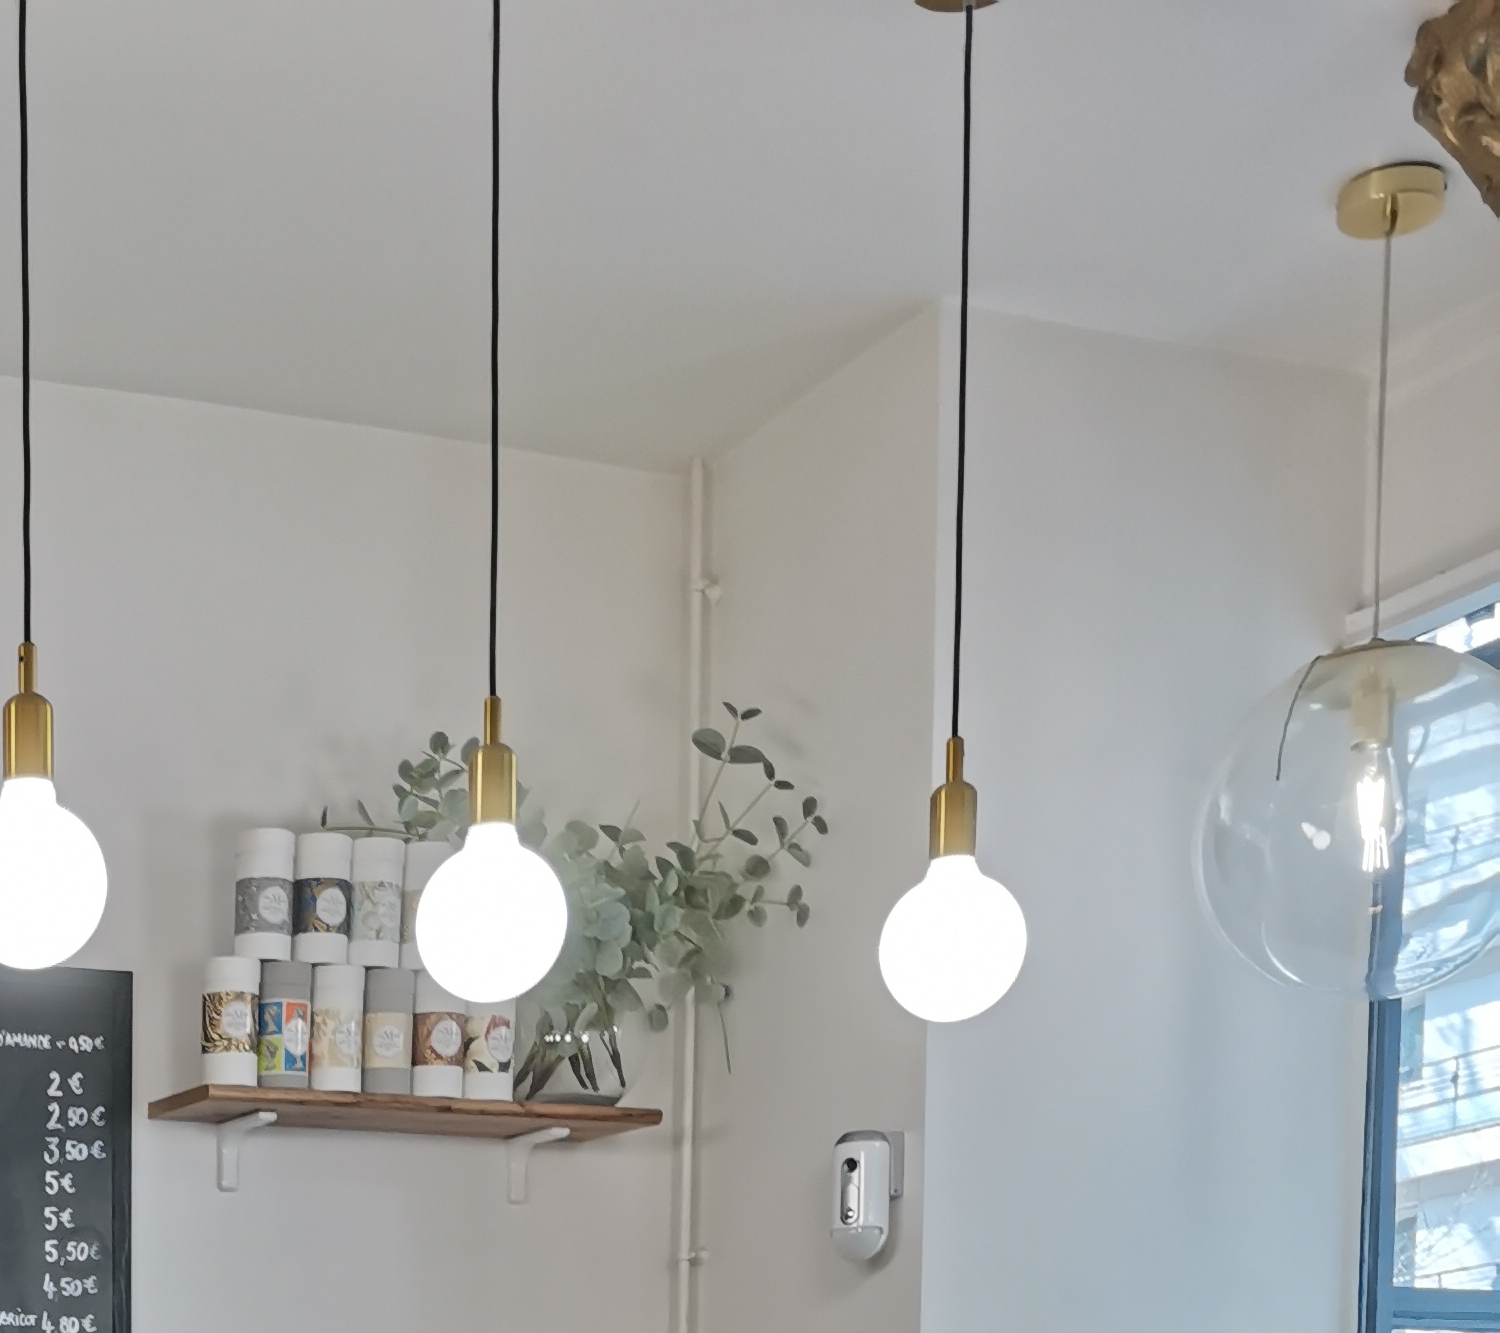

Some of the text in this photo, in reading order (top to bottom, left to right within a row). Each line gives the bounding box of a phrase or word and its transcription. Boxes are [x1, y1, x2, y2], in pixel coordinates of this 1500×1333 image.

[44, 1169, 77, 1195] 5€
[43, 1205, 76, 1231] 5€
[44, 1238, 101, 1267] 5,50€
